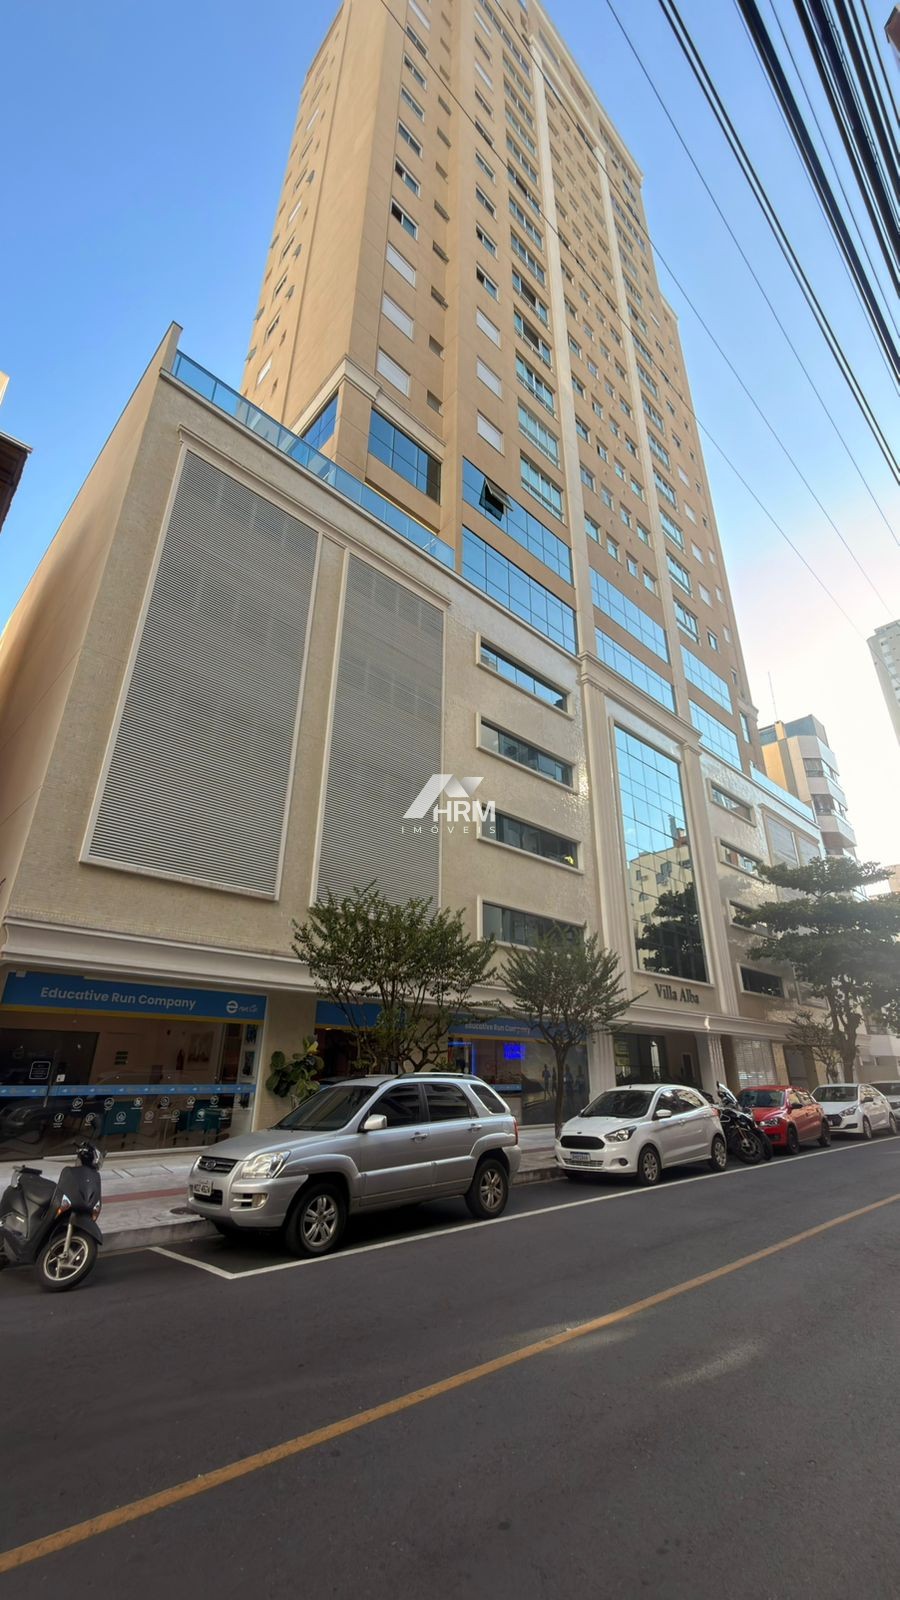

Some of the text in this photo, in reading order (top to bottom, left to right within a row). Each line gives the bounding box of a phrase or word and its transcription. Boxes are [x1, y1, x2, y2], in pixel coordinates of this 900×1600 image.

[40, 987, 196, 1010] Educative Run Company
[654, 983, 700, 1004] Villa Alba
